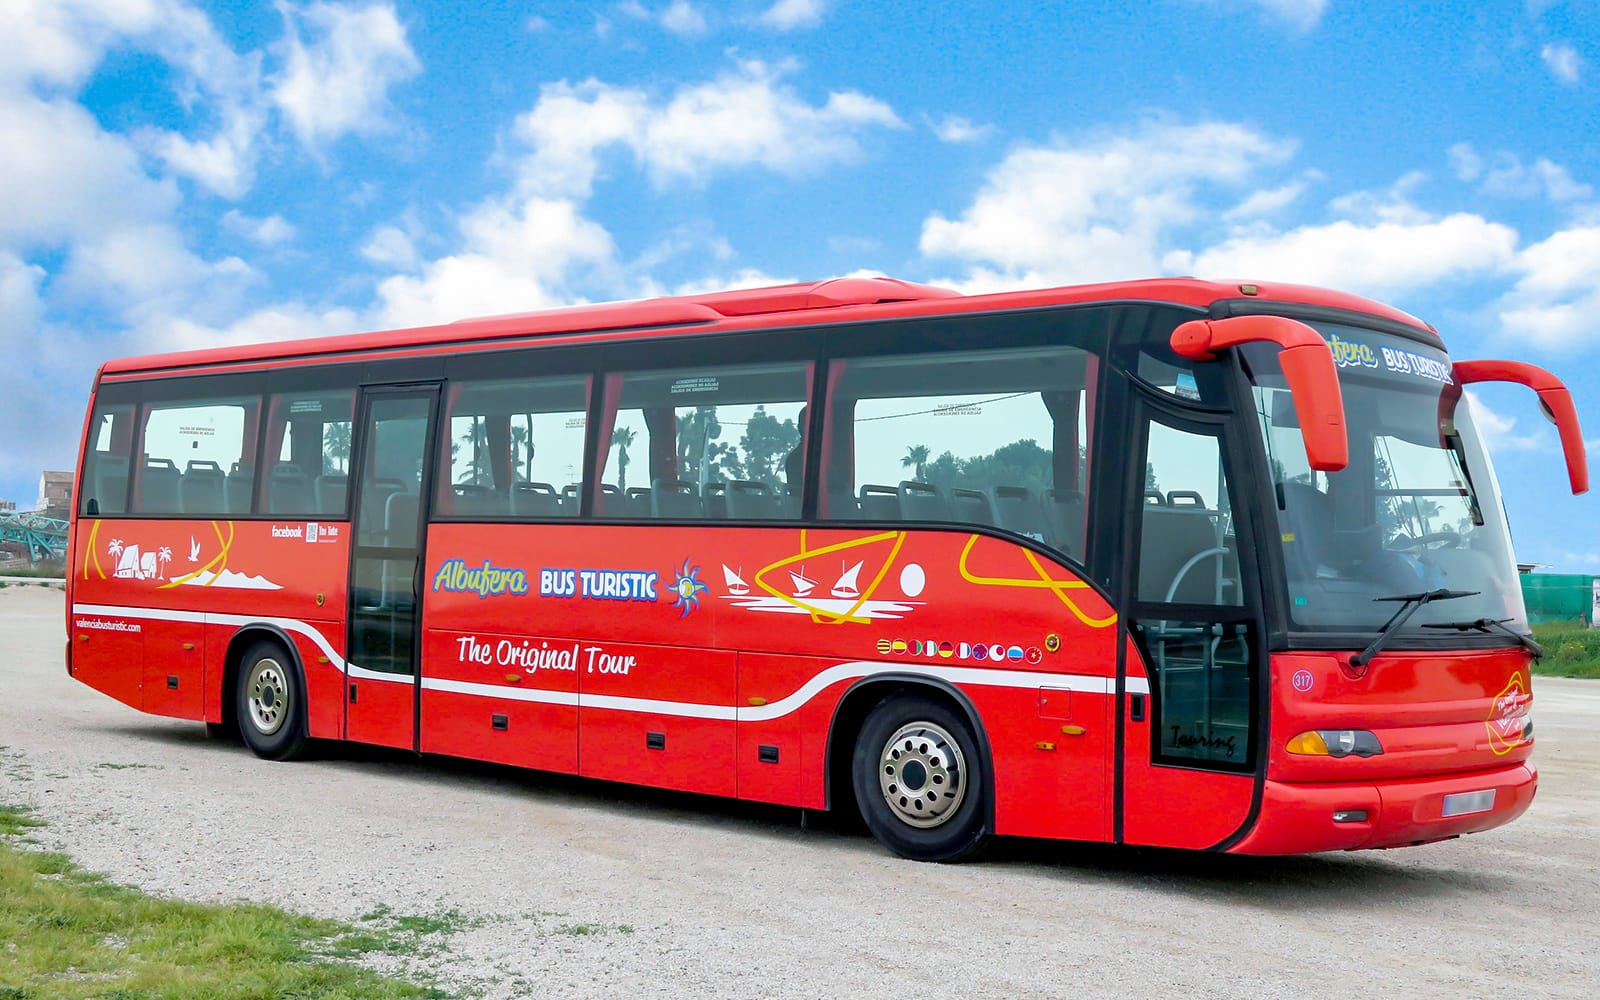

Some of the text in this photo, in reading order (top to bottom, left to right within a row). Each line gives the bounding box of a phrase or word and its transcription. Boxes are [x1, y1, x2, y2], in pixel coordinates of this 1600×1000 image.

[1380, 344, 1411, 374] BUS
[272, 525, 303, 538] facebook
[433, 559, 658, 601] Albufera BUS TURISTIC
[75, 617, 142, 633] valenciabusturistic.com
[456, 635, 637, 675] The Original Tour
[1295, 674, 1311, 687] 317
[1171, 725, 1236, 758] Touring
